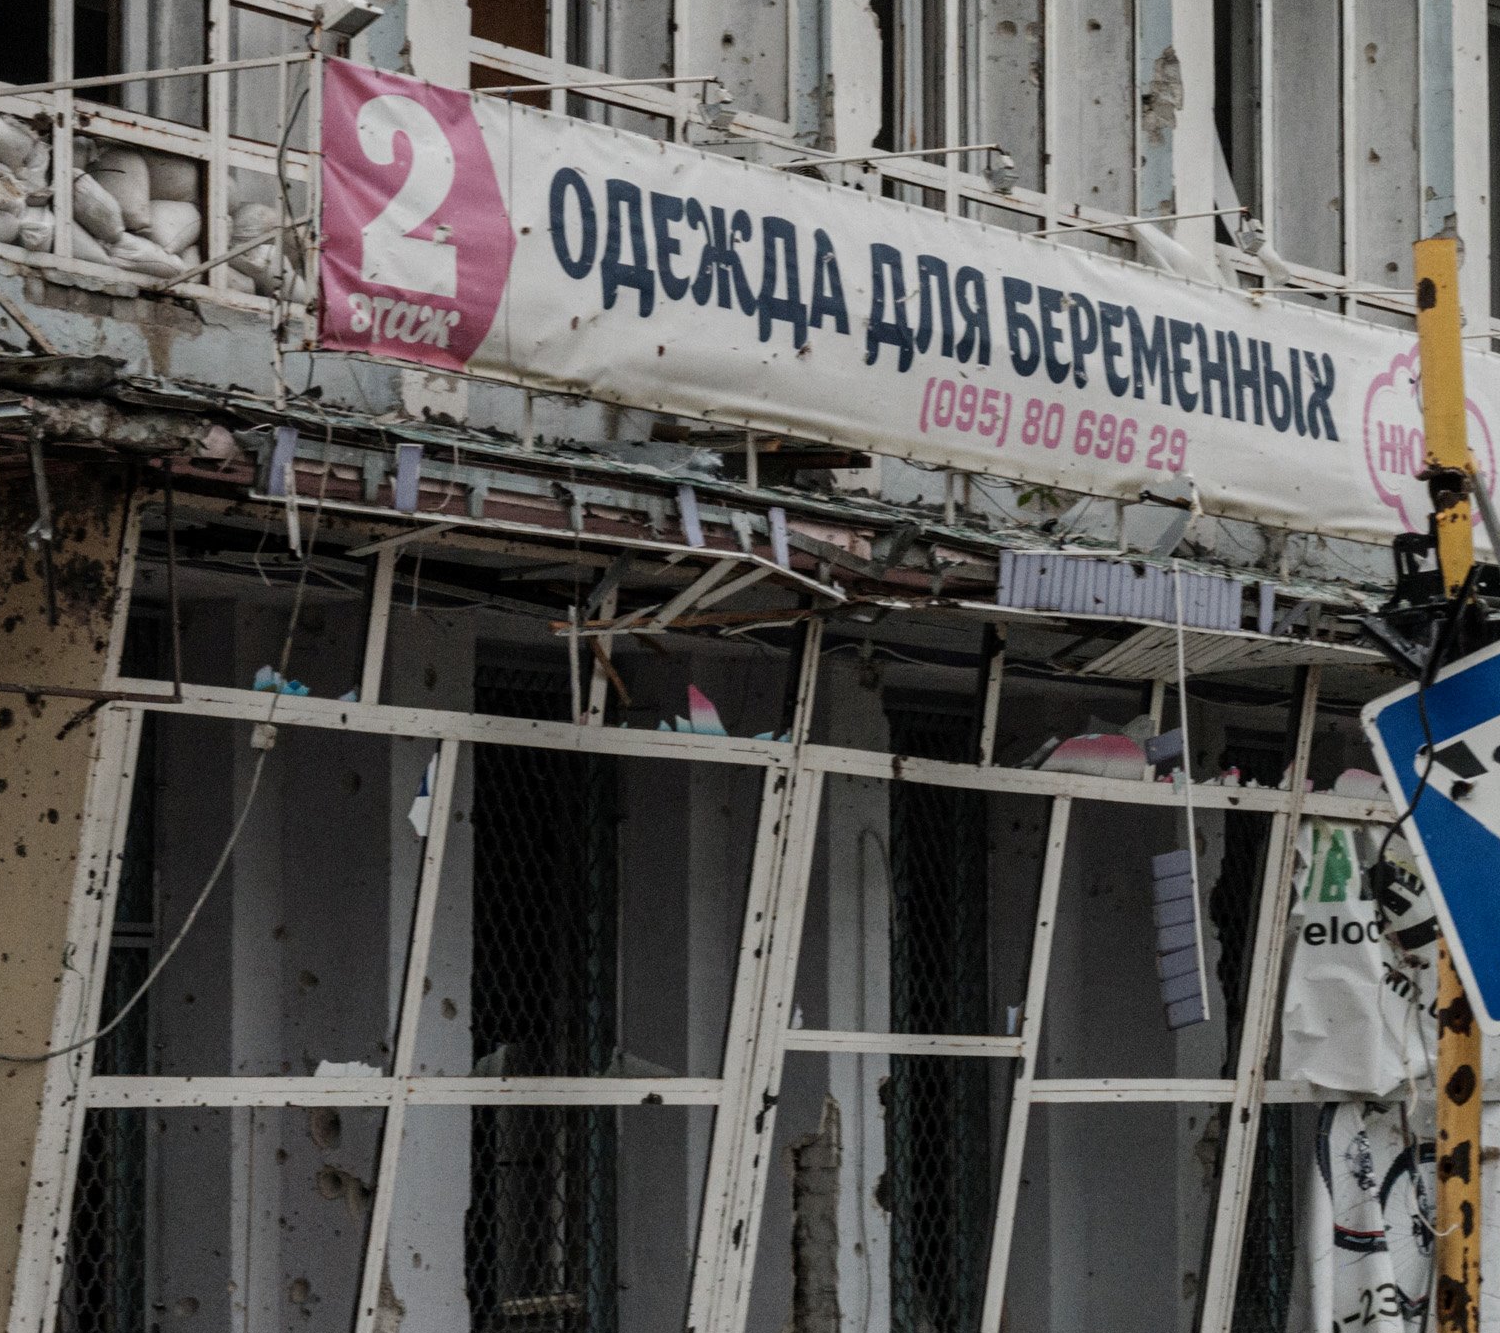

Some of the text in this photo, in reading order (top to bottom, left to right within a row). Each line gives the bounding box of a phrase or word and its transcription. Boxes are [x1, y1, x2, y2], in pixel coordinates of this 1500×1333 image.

[357, 94, 457, 298] 2
[347, 292, 461, 349] этаж
[550, 166, 1339, 441] ОДЕЖДА ДЛЯ БЕРЕМЕННЫХ
[919, 376, 1188, 474] (095) 80 696 29
